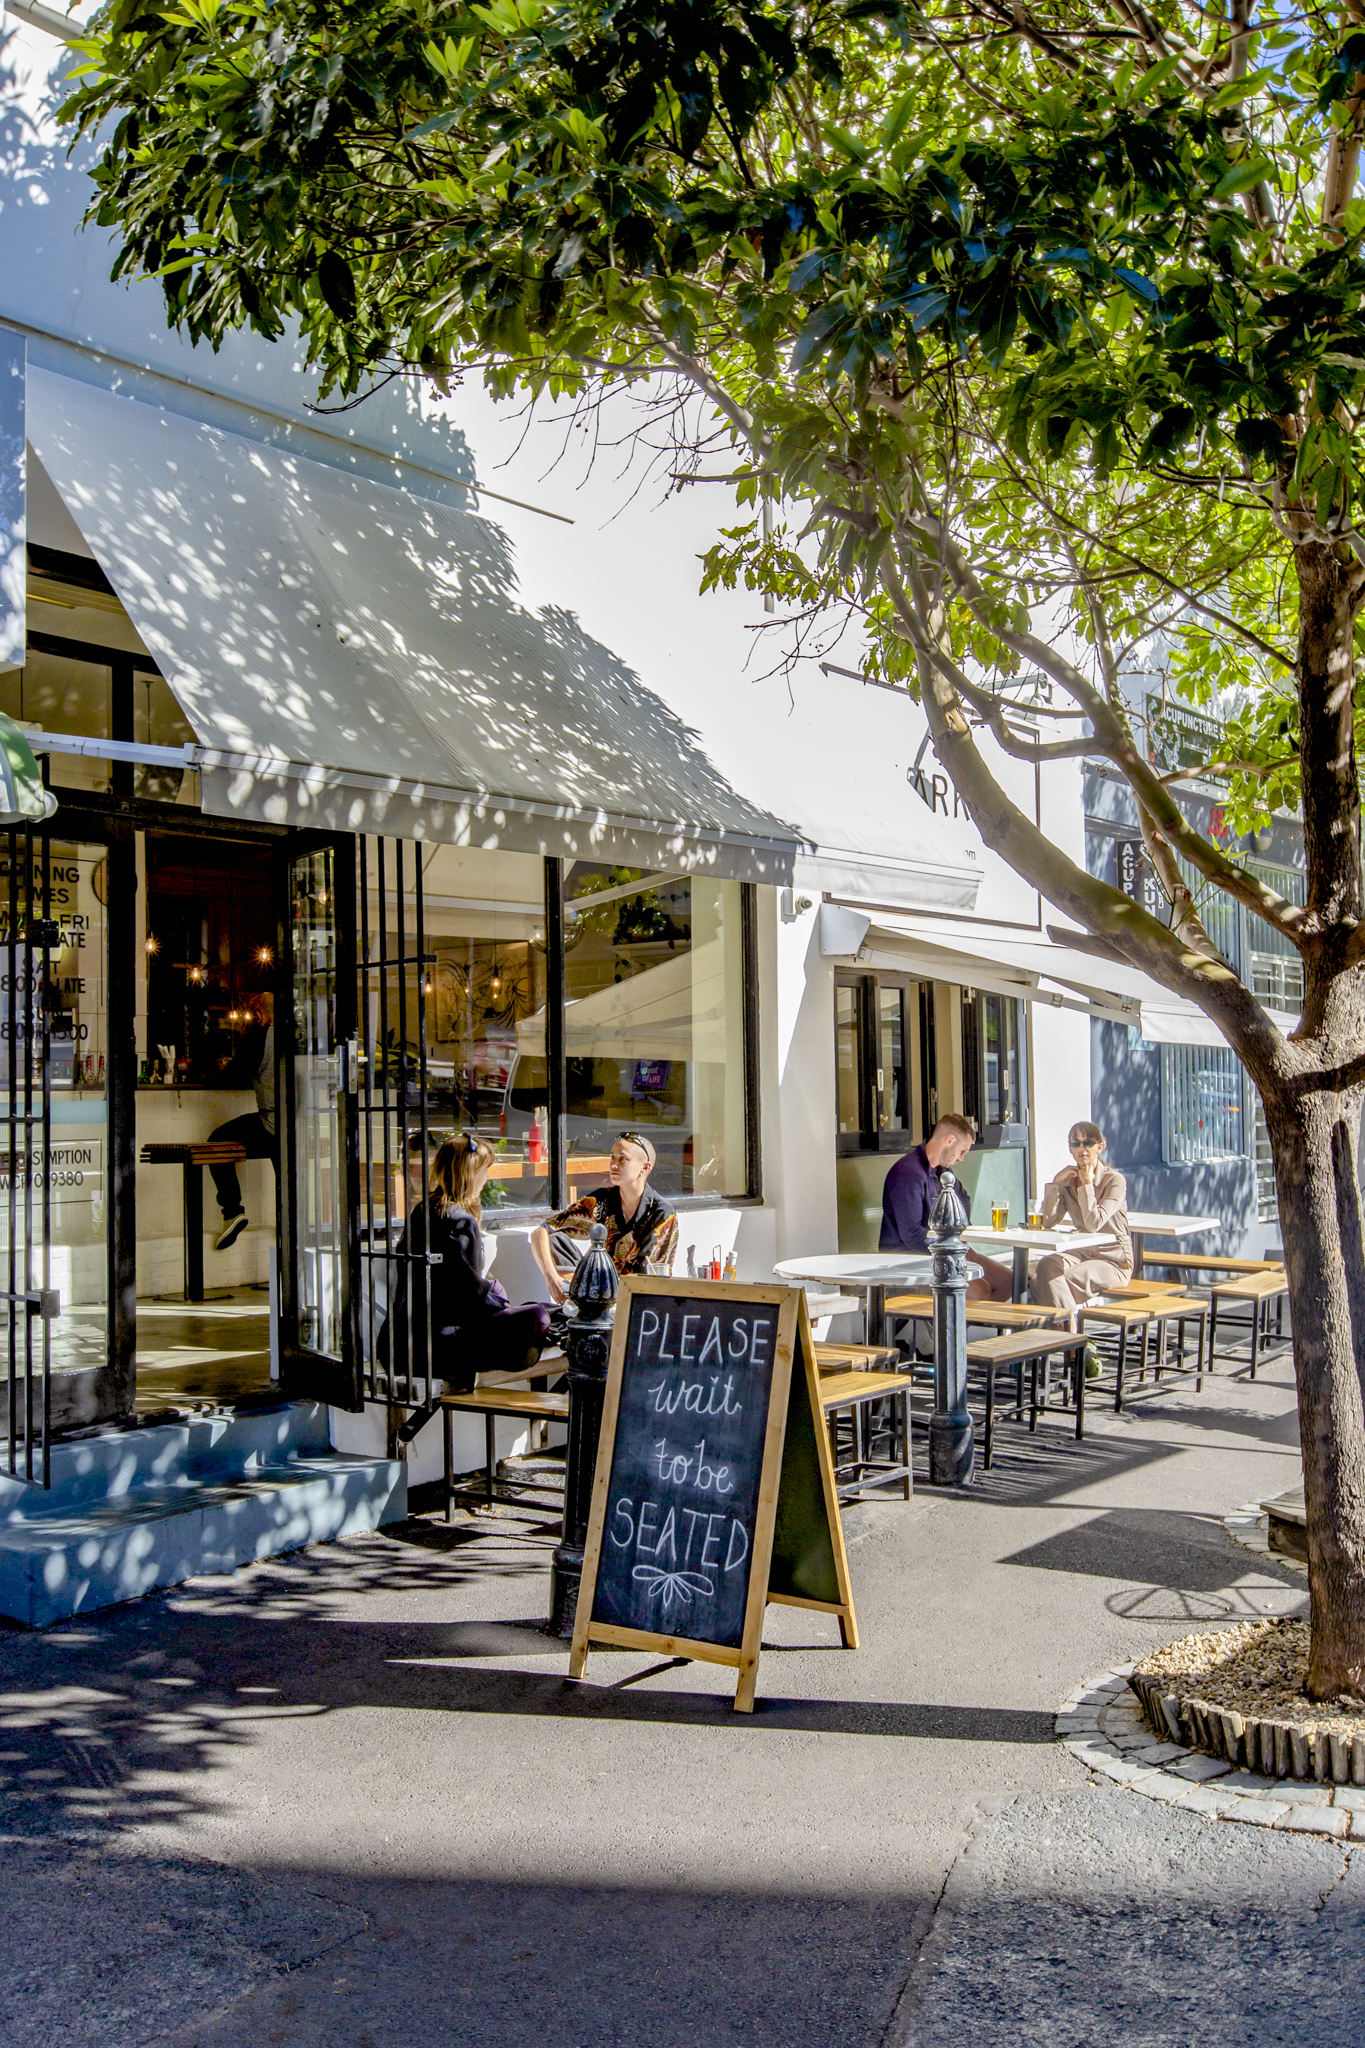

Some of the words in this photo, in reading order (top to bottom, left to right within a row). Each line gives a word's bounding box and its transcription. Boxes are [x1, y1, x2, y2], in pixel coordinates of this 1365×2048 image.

[1161, 706, 1219, 741] ACUPUNCTURE
[60, 914, 89, 930] FRI
[637, 1310, 771, 1364] PLEASE
[648, 1375, 742, 1415] wait
[610, 1497, 749, 1572] SEATED
